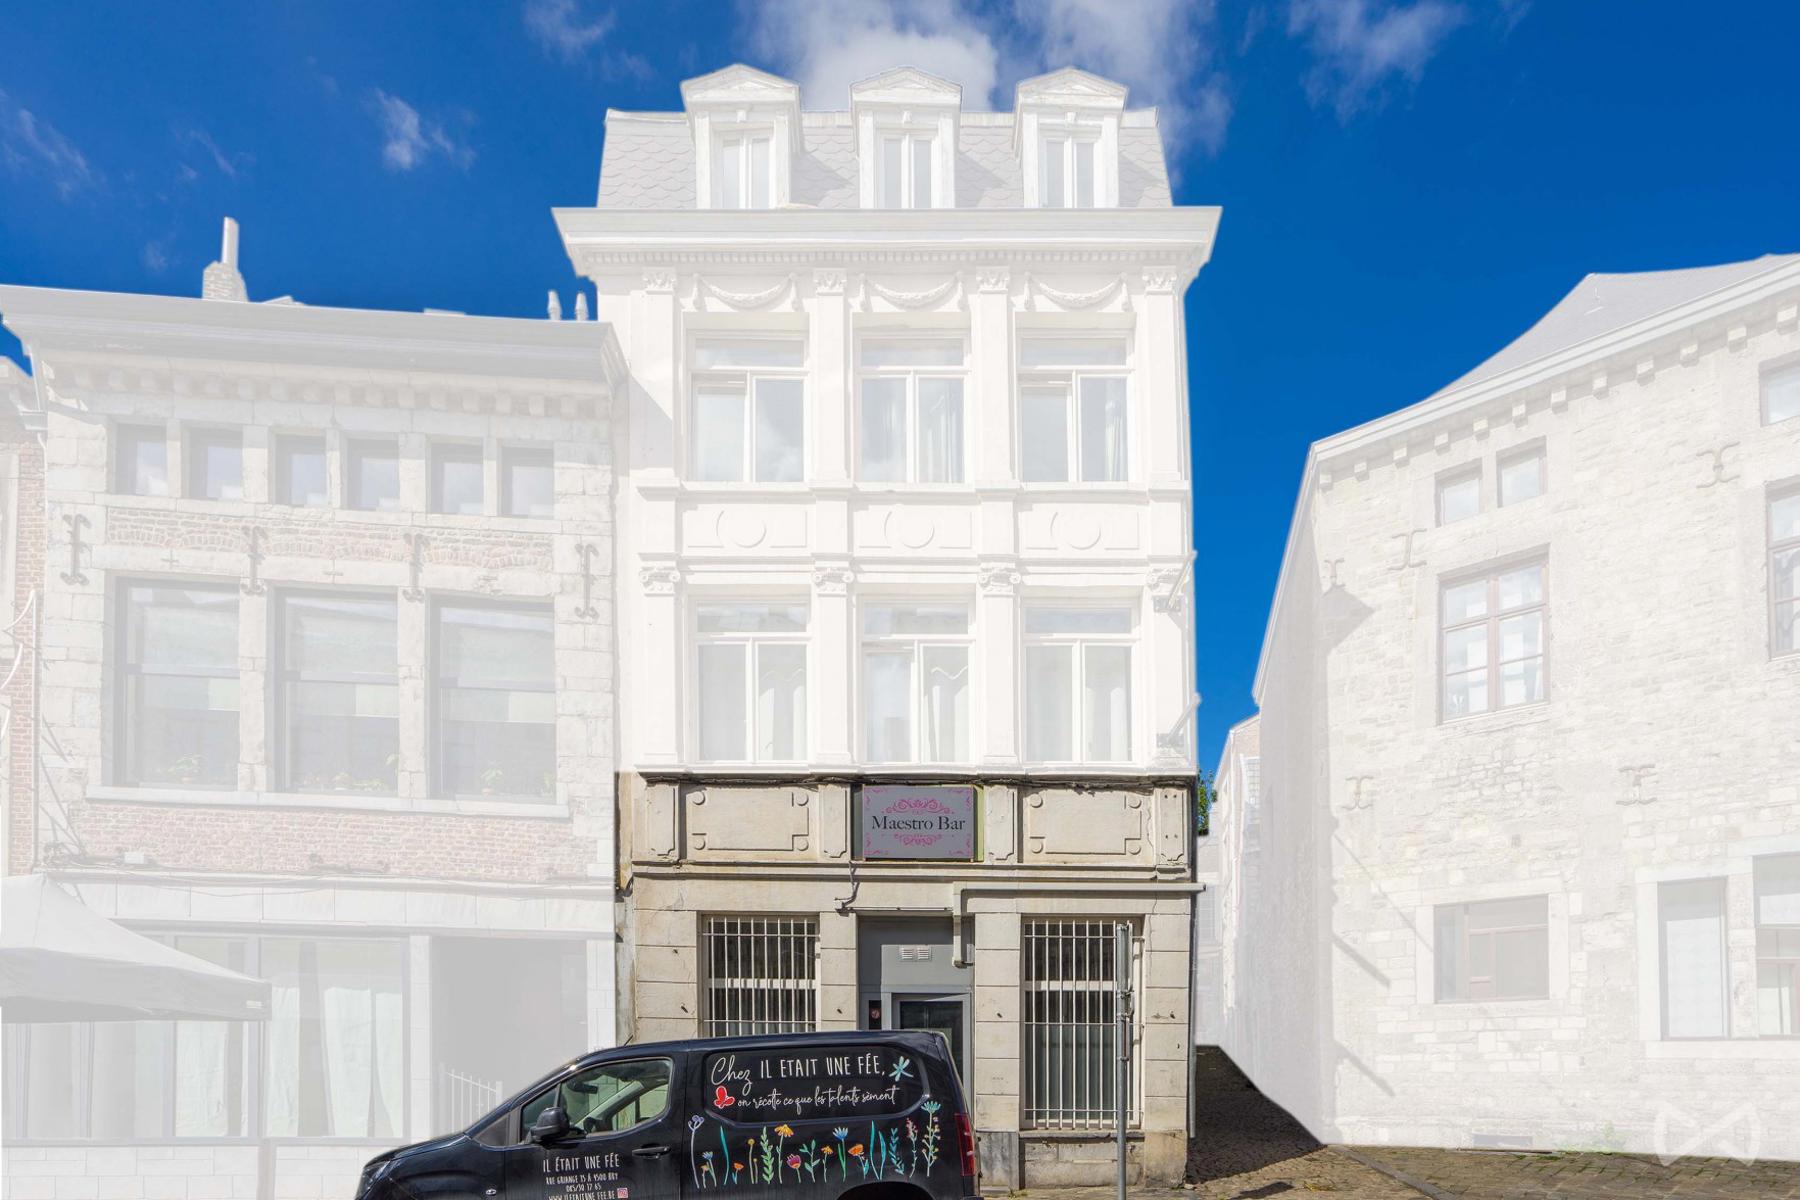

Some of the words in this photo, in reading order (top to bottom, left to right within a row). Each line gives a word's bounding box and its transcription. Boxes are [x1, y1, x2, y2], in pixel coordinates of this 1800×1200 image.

[872, 815, 933, 830] Maestro
[938, 815, 966, 830] Bar
[711, 1054, 753, 1097] Chez
[760, 1059, 772, 1079] IL
[780, 1058, 818, 1078] ETAIT
[826, 1056, 851, 1076] UNE
[783, 1096, 794, 1106] ce
[793, 1096, 813, 1115] que
[813, 1085, 826, 1107] les
[822, 1084, 861, 1108] talents
[543, 1159, 551, 1173] IL
[555, 1157, 580, 1172] ÉTAIT
[584, 1155, 600, 1169] UNE
[604, 1153, 620, 1168] FÉE
